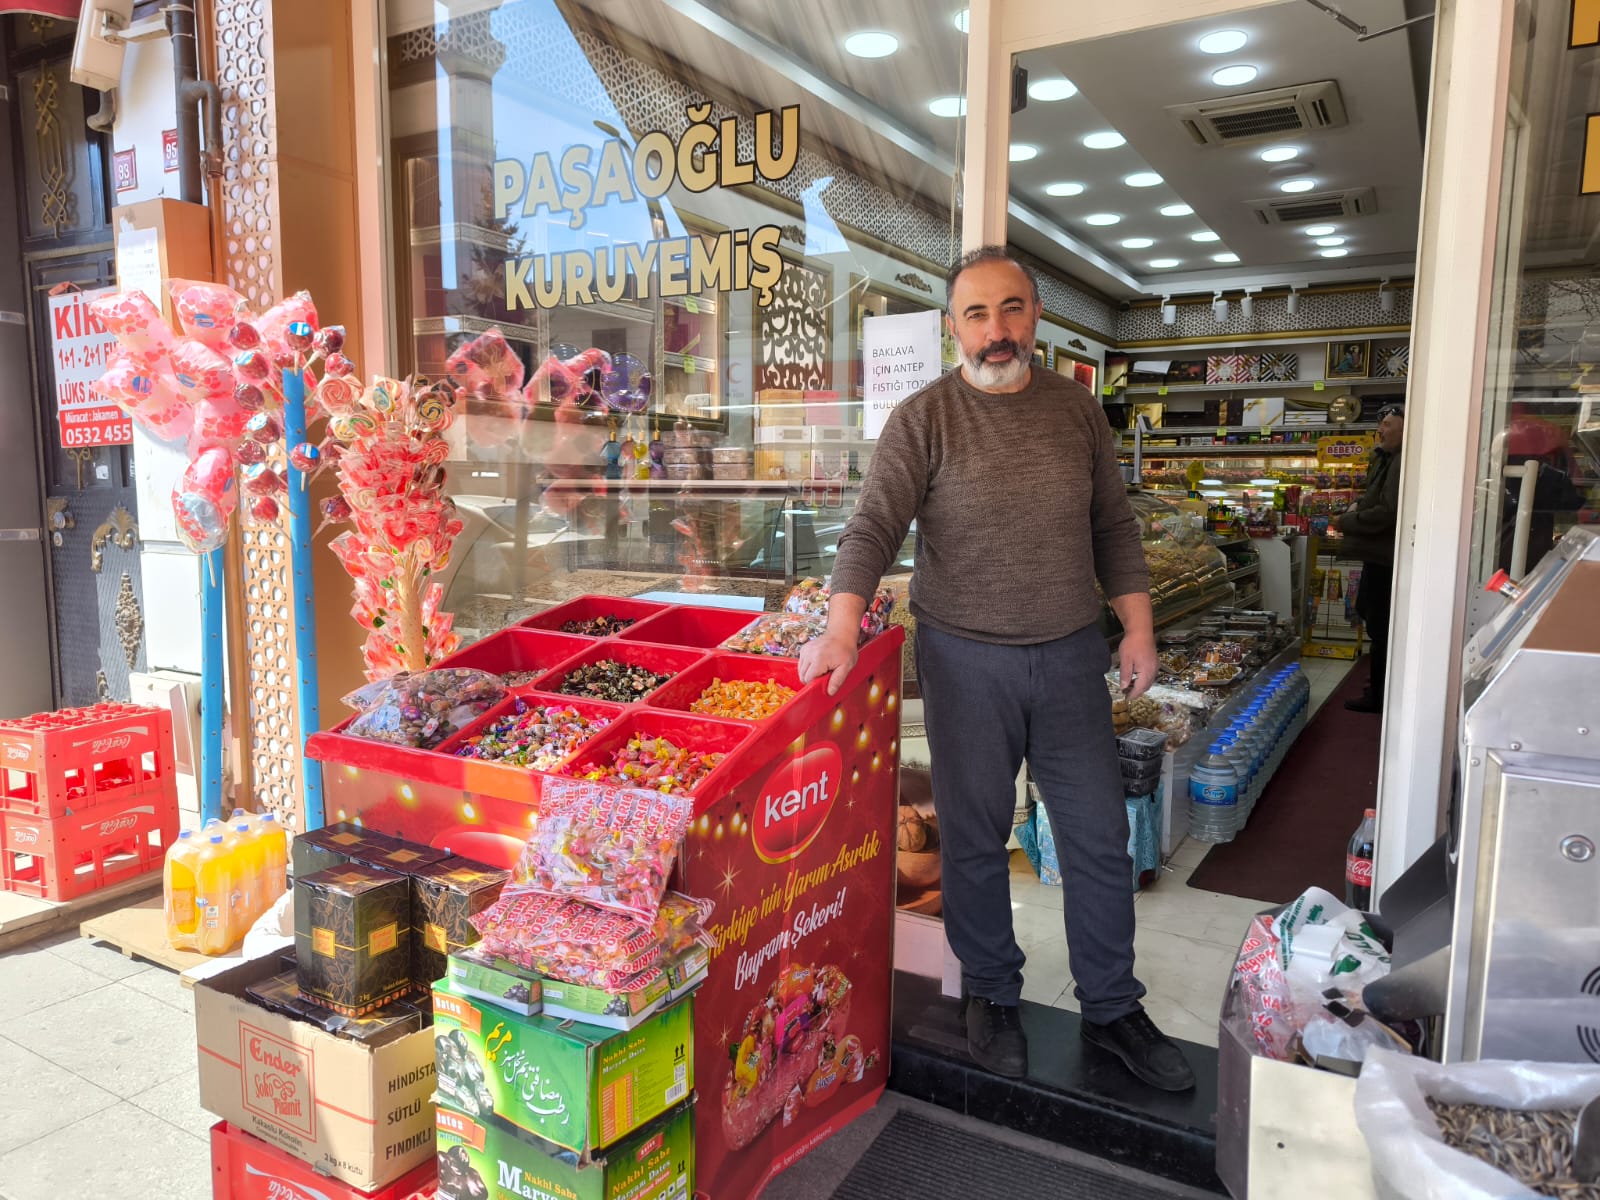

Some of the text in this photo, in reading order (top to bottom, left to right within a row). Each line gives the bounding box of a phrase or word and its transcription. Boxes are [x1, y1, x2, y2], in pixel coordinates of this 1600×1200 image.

[165, 142, 178, 159] 95
[118, 163, 130, 180] 93
[492, 101, 801, 230] PAŞAOĞLU
[872, 345, 915, 358] BAKLAVA
[872, 362, 925, 377] İÇİN ANTEP
[59, 378, 86, 406] LÜKS
[872, 380, 904, 392] FISTIĞI
[65, 423, 132, 445] 0532 455
[1327, 444, 1363, 455] BEBETO
[763, 770, 829, 828] kent
[783, 862, 831, 914] Yarım
[830, 830, 882, 879] Asırlık
[734, 886, 847, 991] Bayram Şekeri!
[250, 1037, 301, 1077] Ender
[387, 1096, 421, 1126] SÜTLÜ
[385, 1127, 432, 1160] FINDIKLI
[524, 1171, 577, 1200] Nakhl Sabz
[613, 1165, 644, 1195] Nakhl
[648, 1147, 671, 1169] Sabz
